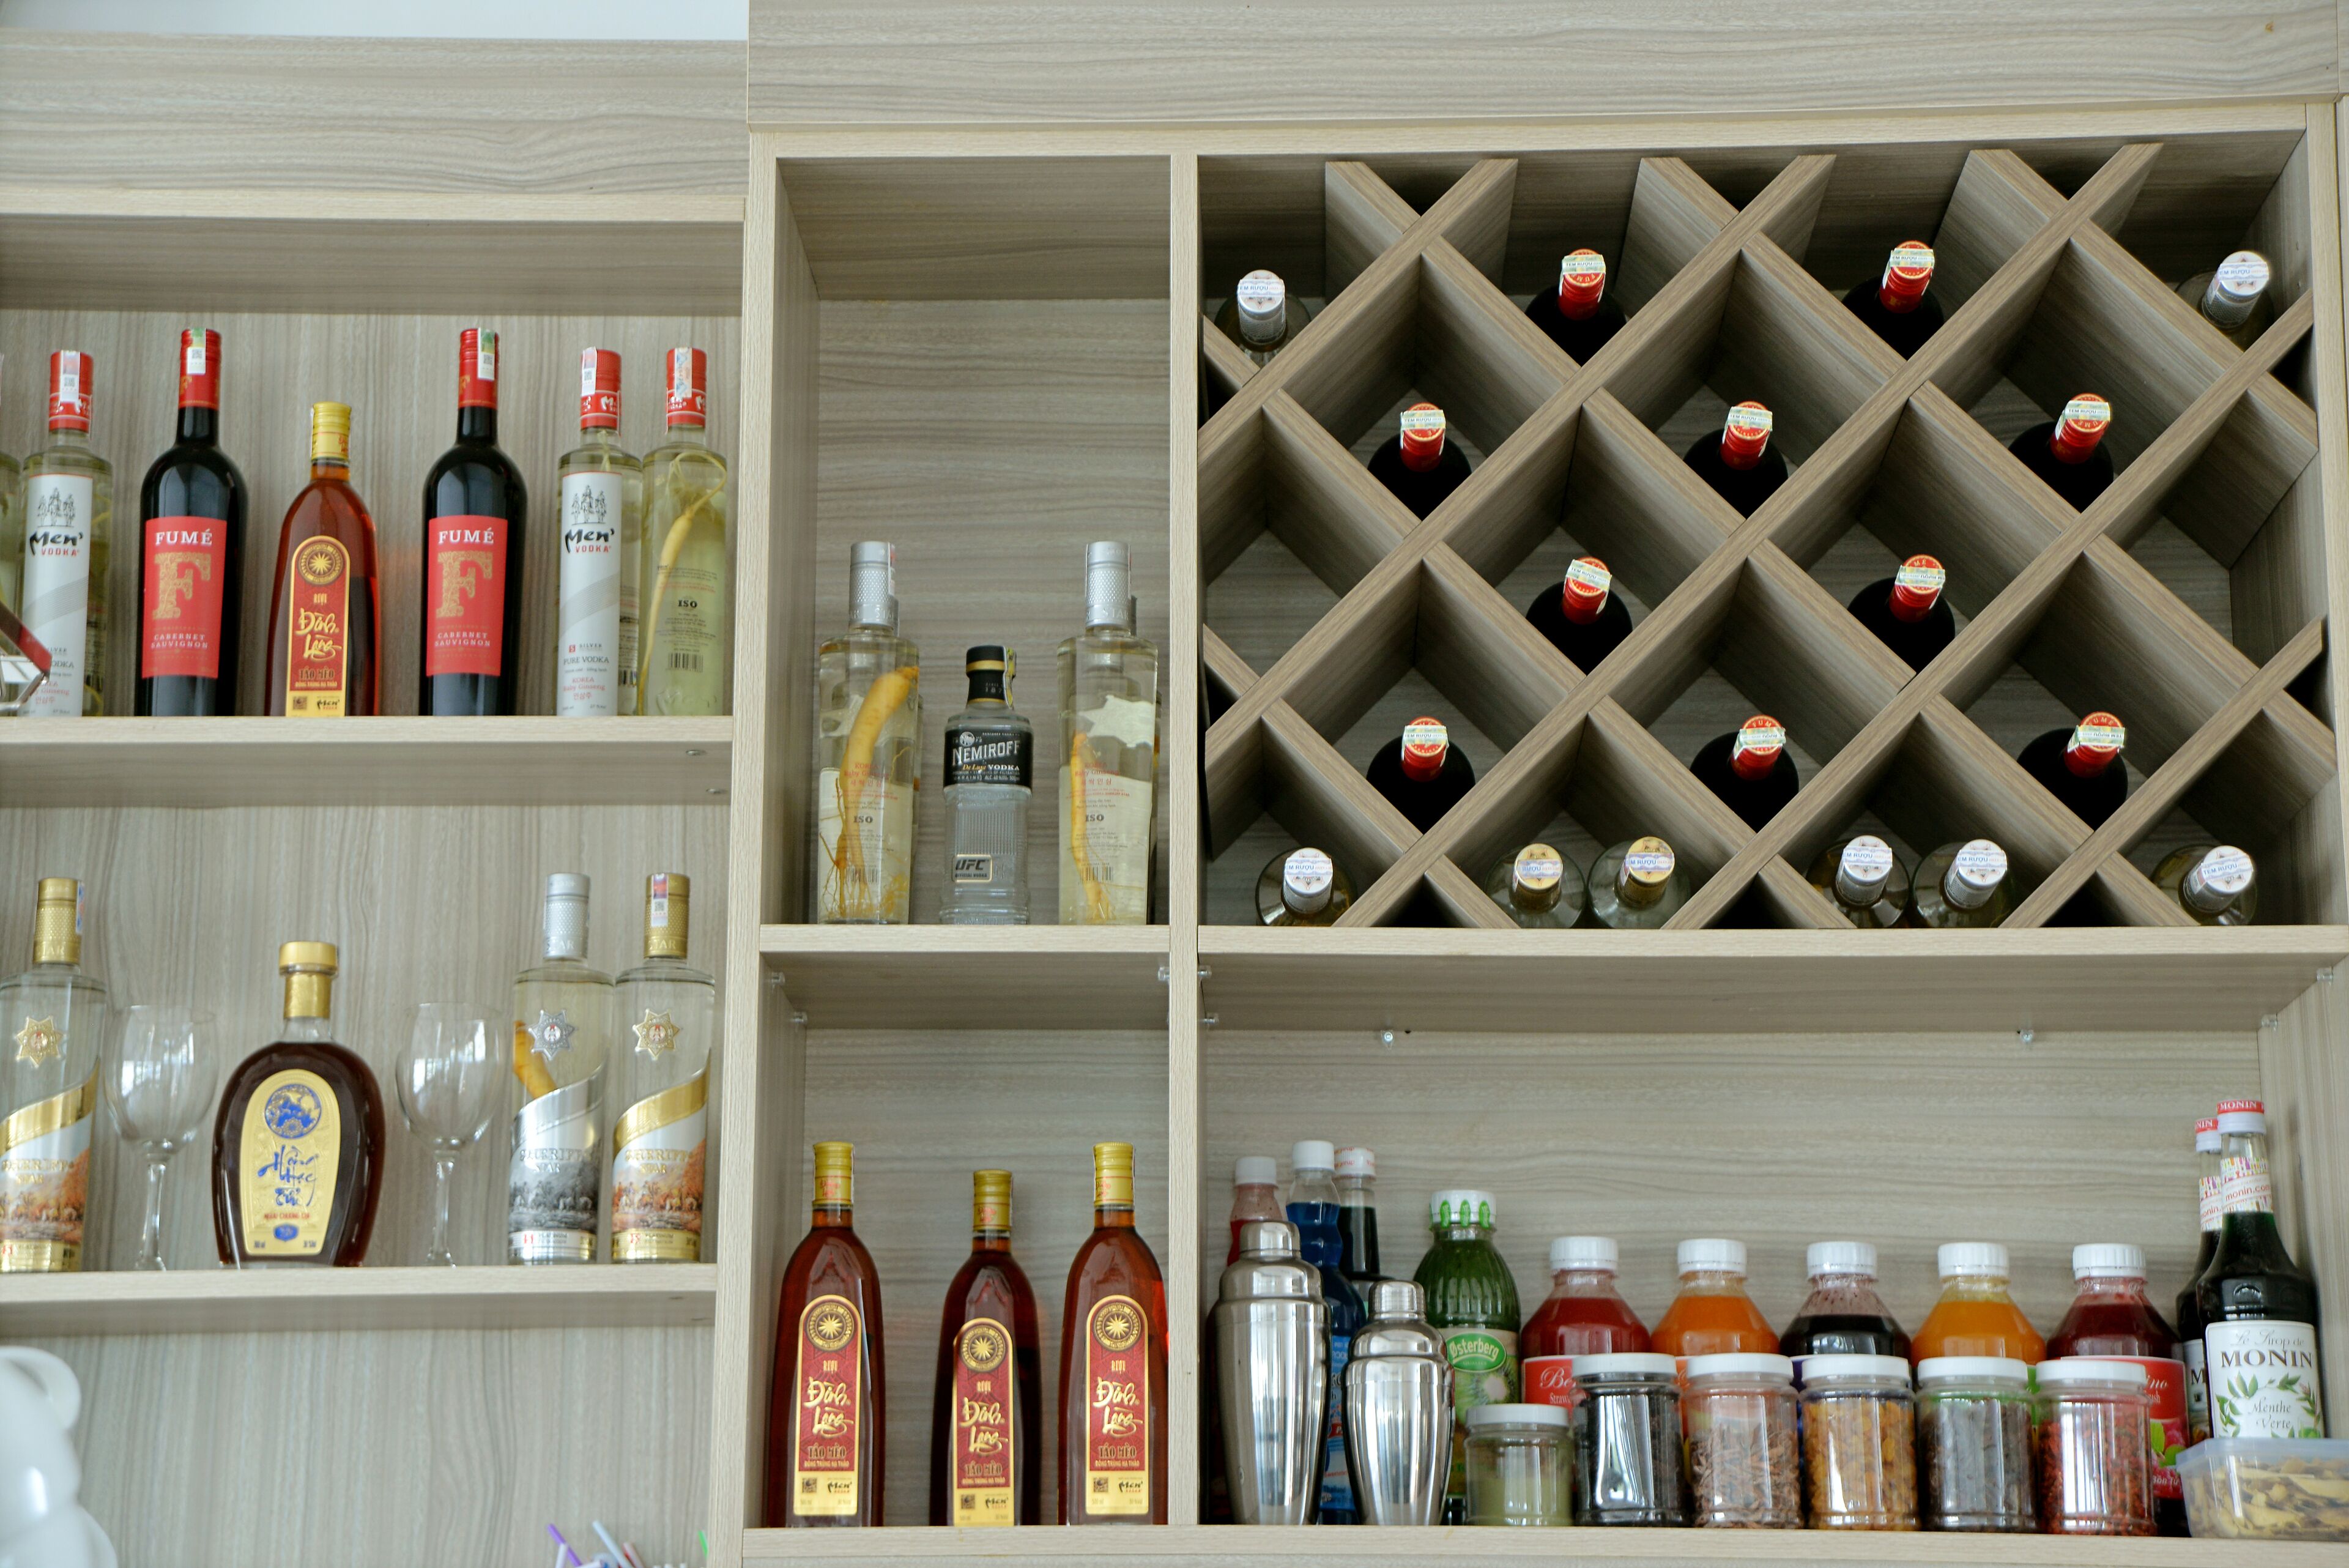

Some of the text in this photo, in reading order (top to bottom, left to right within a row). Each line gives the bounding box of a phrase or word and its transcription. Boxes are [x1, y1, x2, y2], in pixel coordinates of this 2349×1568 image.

[155, 529, 213, 546] FUMÉ
[438, 527, 494, 544] FUMÉ
[678, 600, 698, 609] ISO
[952, 740, 1020, 765] NEMIROFF
[956, 859, 986, 870] UFC
[2219, 1101, 2257, 1110] MONIN
[1449, 1338, 1499, 1362] Østerberg
[2293, 1337, 2304, 1346] de
[2221, 1349, 2312, 1369] MONIN
[2248, 1397, 2291, 1414] Menthe
[2256, 1414, 2291, 1429] Verte
